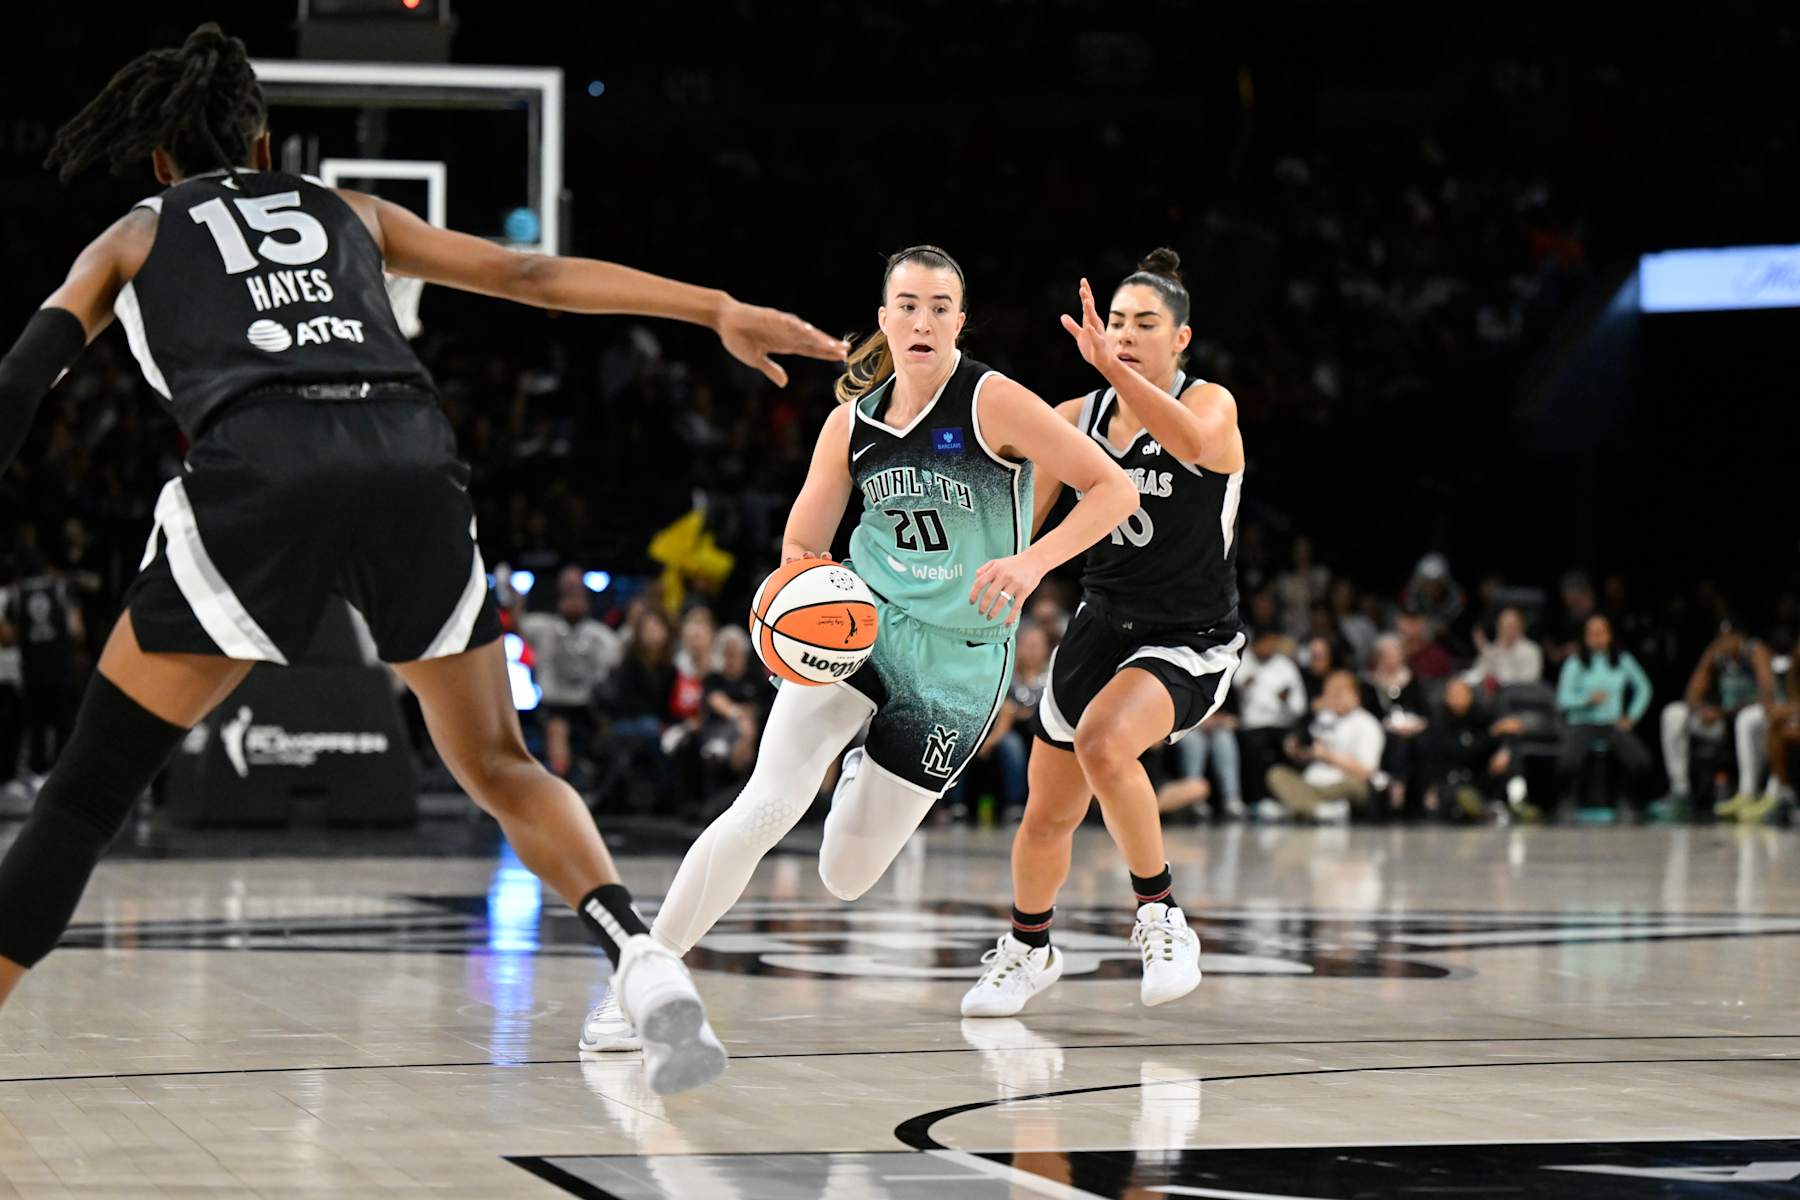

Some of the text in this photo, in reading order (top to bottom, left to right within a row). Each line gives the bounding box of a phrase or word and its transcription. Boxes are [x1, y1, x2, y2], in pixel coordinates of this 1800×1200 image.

[188, 191, 328, 275] 15
[246, 269, 334, 312] HAYES
[297, 316, 366, 346] AT&T
[1142, 440, 1161, 456] ally
[861, 467, 974, 511] QUALITY
[1124, 467, 1173, 497] GAS
[883, 508, 950, 553] 20
[911, 563, 963, 580] Webull
